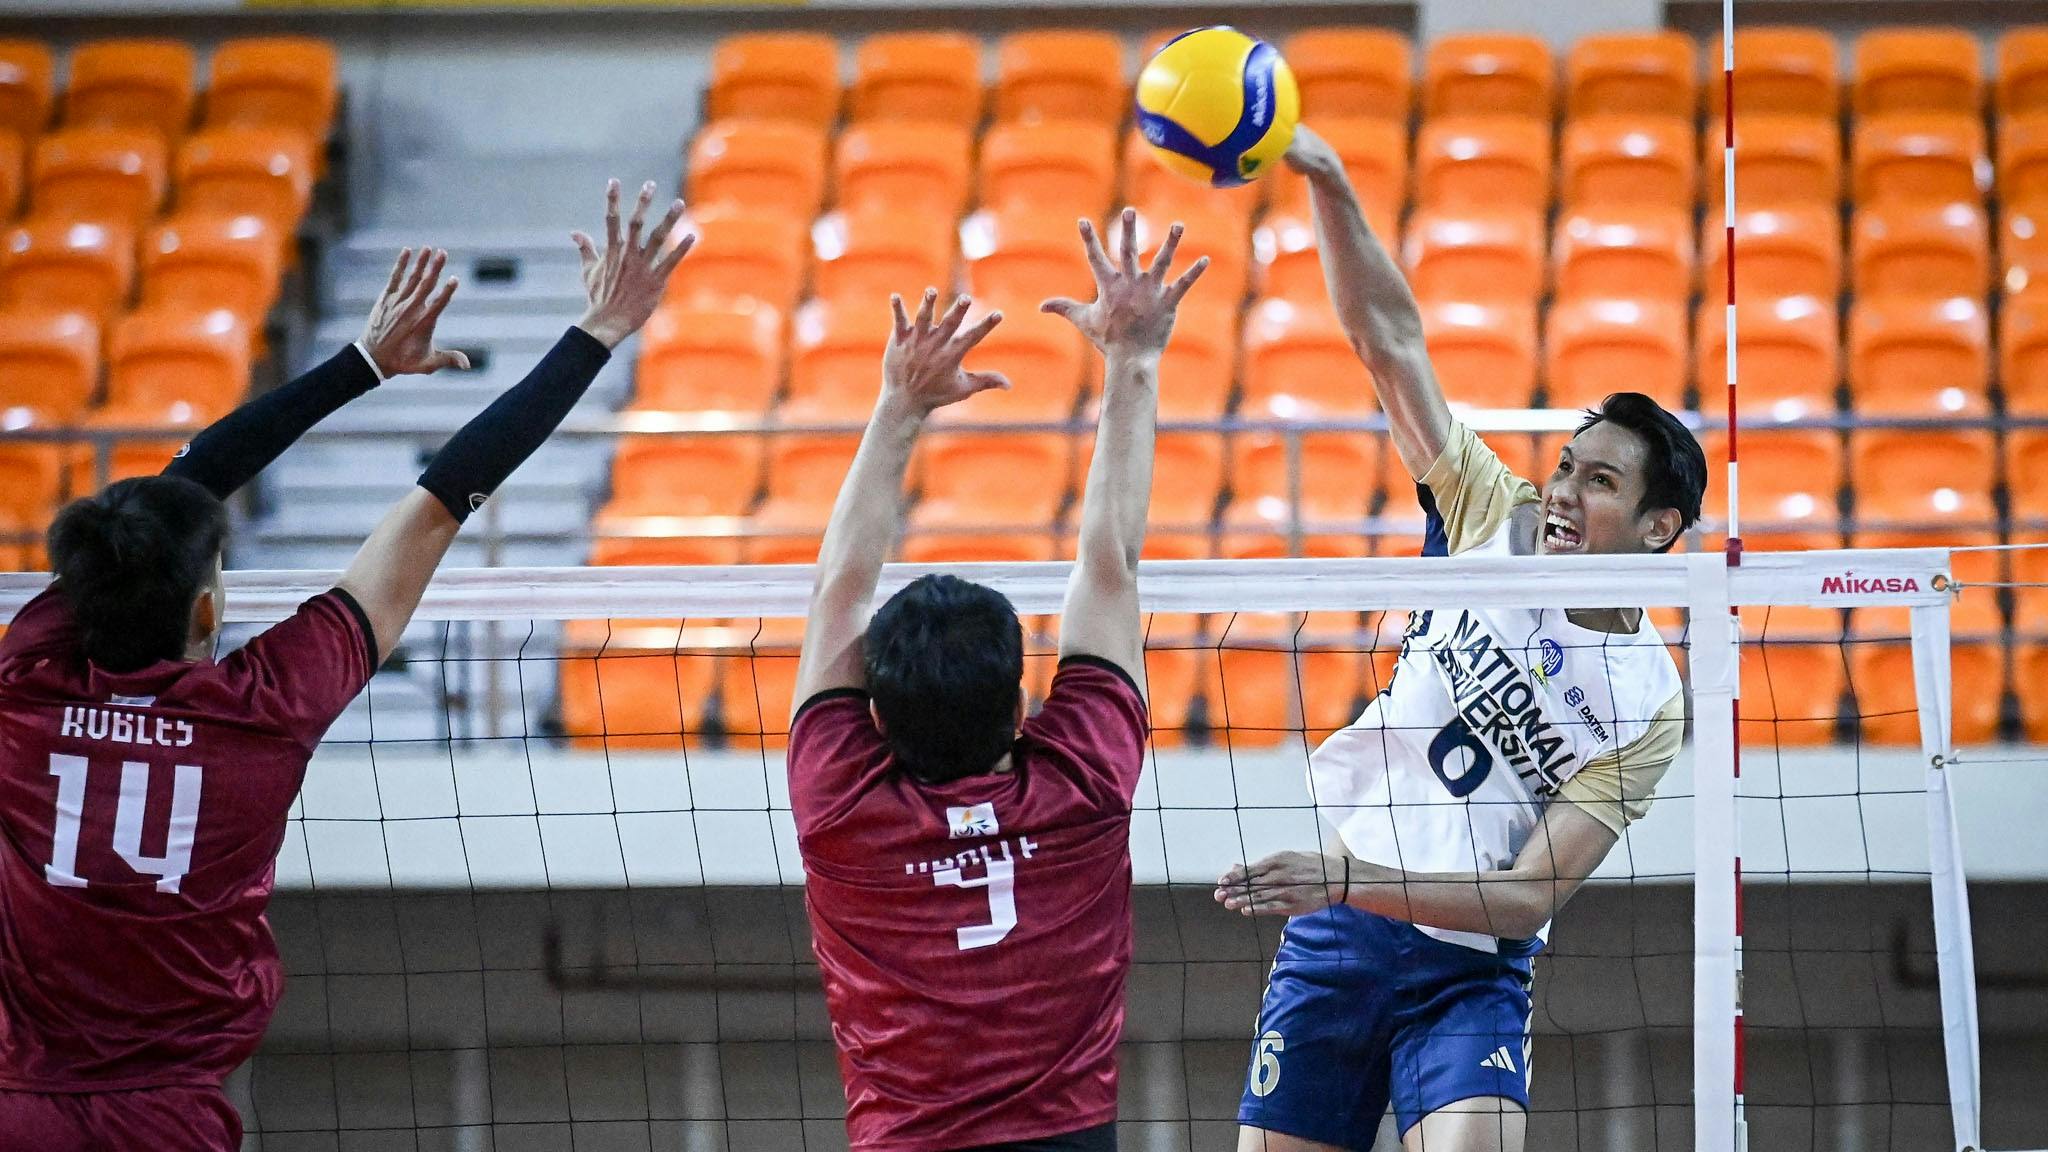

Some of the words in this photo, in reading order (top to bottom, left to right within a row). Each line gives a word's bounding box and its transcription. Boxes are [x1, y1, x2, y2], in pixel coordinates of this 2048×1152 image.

[1821, 571, 1919, 594] MIKASA
[1451, 609, 1576, 783] NATIONAL
[1580, 705, 1609, 743] DATEM
[45, 753, 203, 894] 14
[1250, 1030, 1284, 1097] 6
